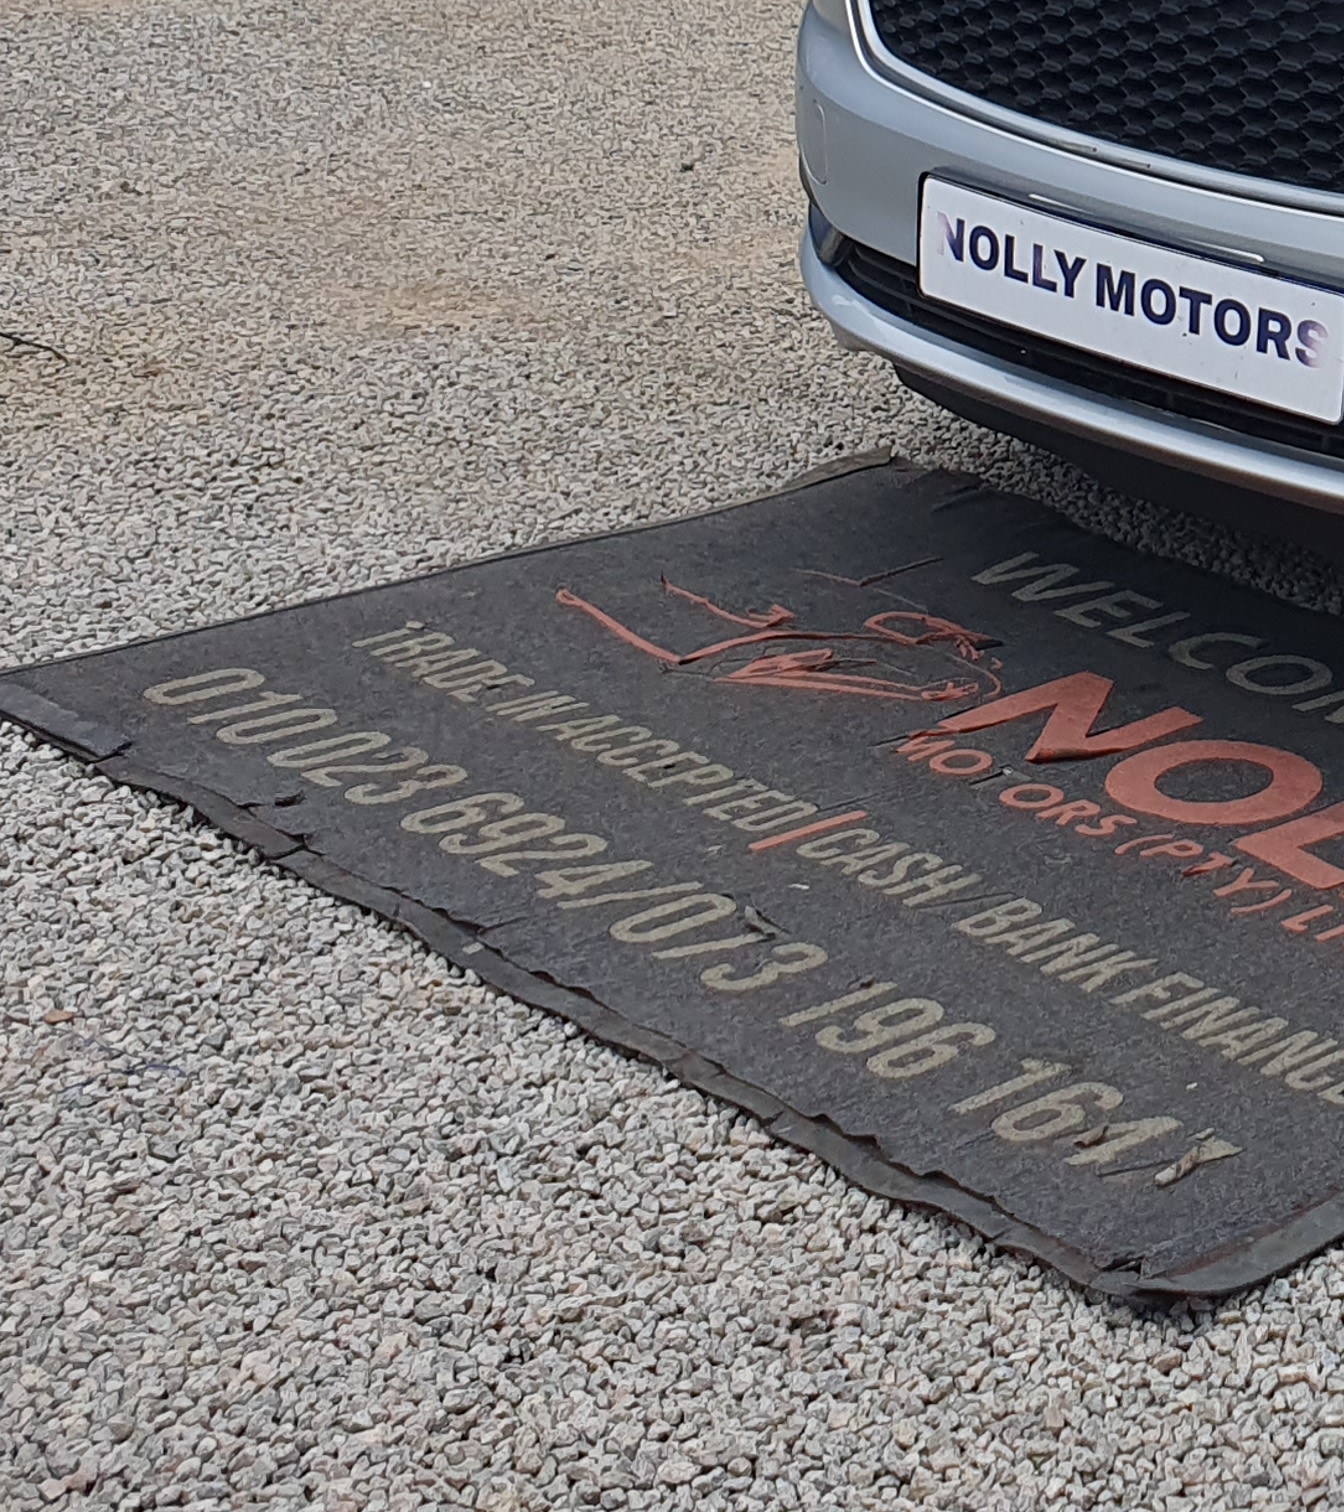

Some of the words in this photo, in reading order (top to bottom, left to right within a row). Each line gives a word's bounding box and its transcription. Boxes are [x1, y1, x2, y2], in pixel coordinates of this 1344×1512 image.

[937, 210, 1087, 299] NOLLY
[1095, 262, 1330, 370] MOTORS
[352, 621, 534, 701] TRADE
[486, 691, 589, 721] IN
[778, 982, 995, 1078] 196
